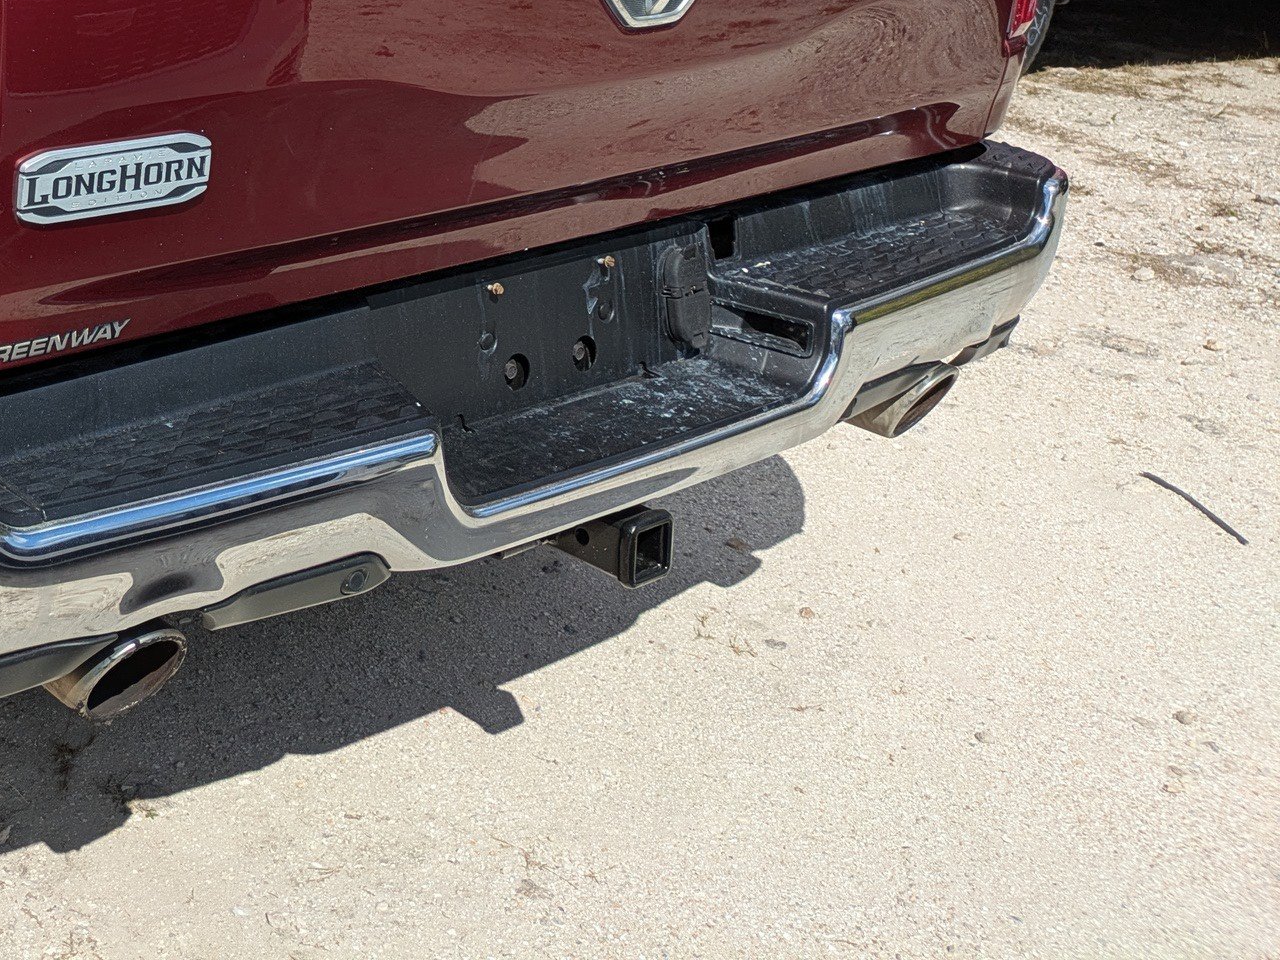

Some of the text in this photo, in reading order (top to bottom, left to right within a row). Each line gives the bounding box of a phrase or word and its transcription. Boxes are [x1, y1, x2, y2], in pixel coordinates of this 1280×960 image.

[74, 150, 167, 170] LARAMIE
[24, 155, 210, 207] LONGHORN
[71, 189, 164, 208] EDITION
